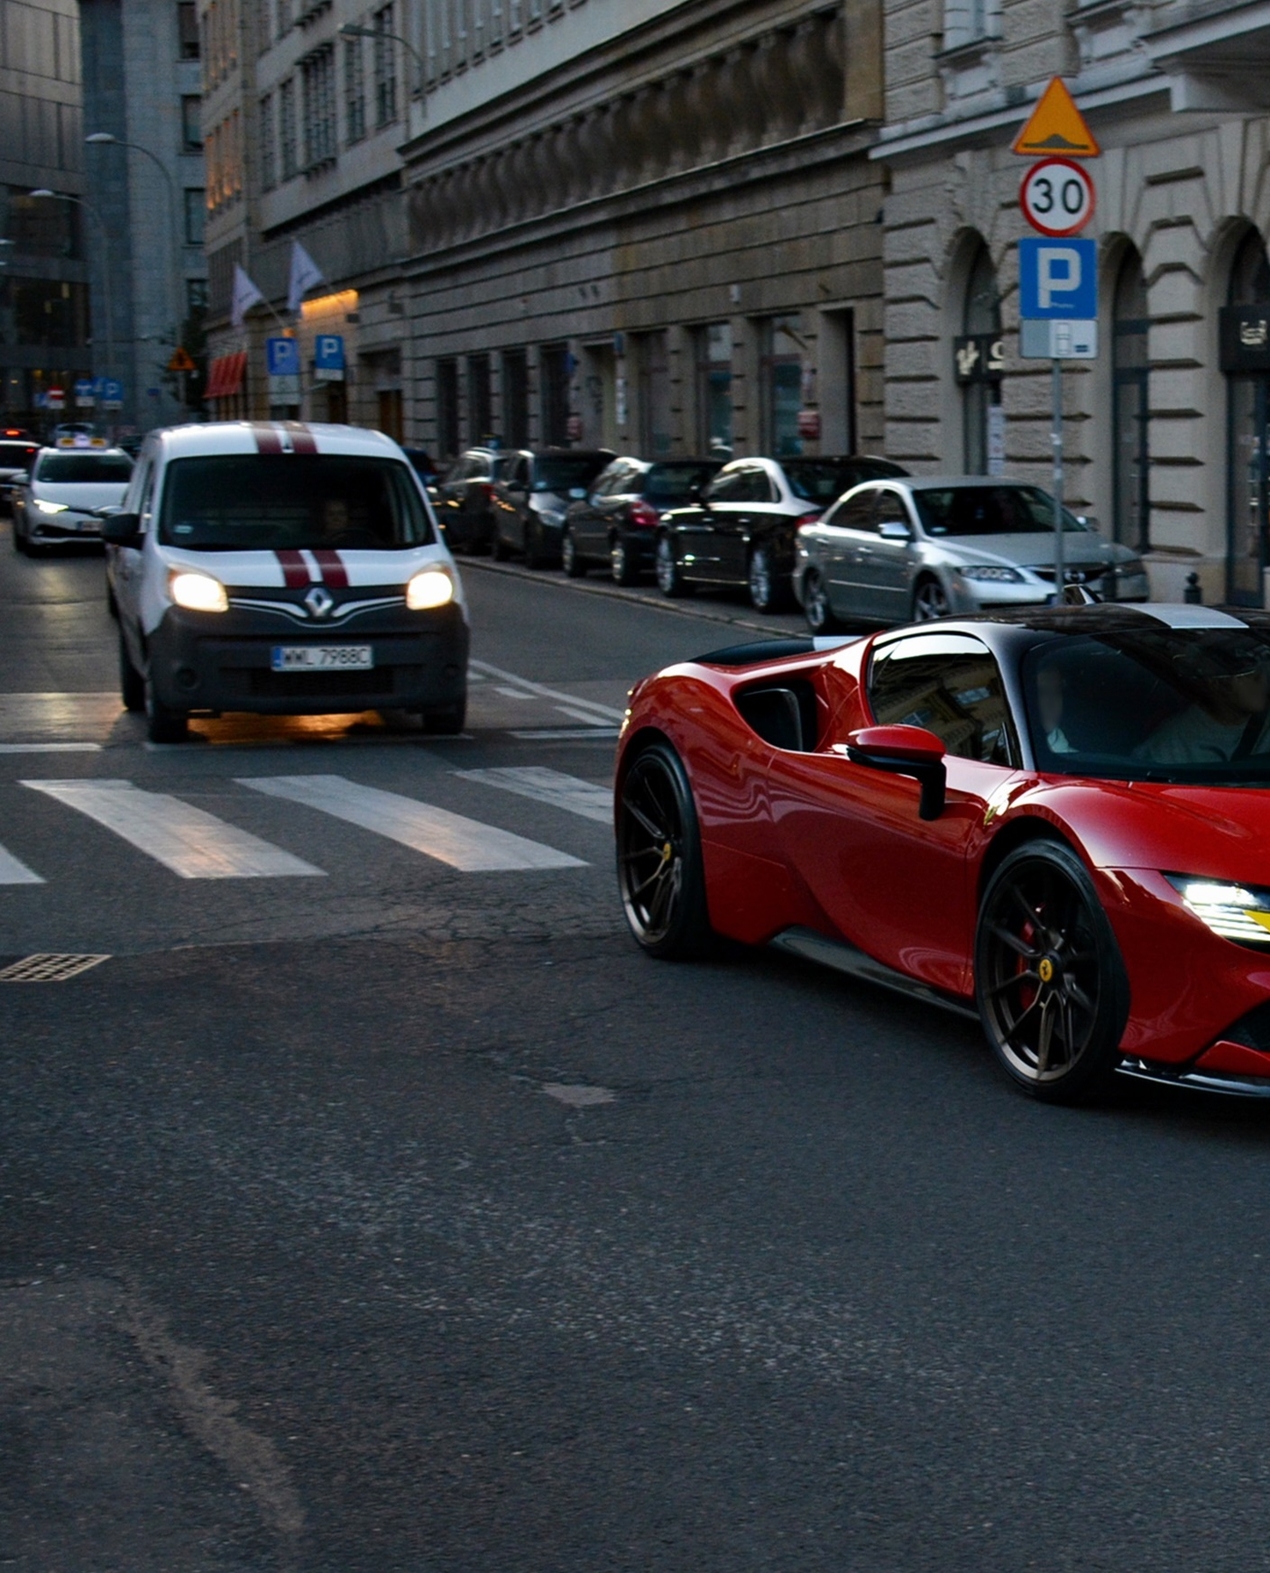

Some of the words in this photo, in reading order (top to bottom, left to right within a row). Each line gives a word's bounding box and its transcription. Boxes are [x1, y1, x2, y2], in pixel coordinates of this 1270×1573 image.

[1032, 179, 1085, 214] 30
[1038, 248, 1082, 308] P
[274, 341, 291, 364] P
[322, 338, 339, 359] P
[319, 648, 369, 665] 7988C
